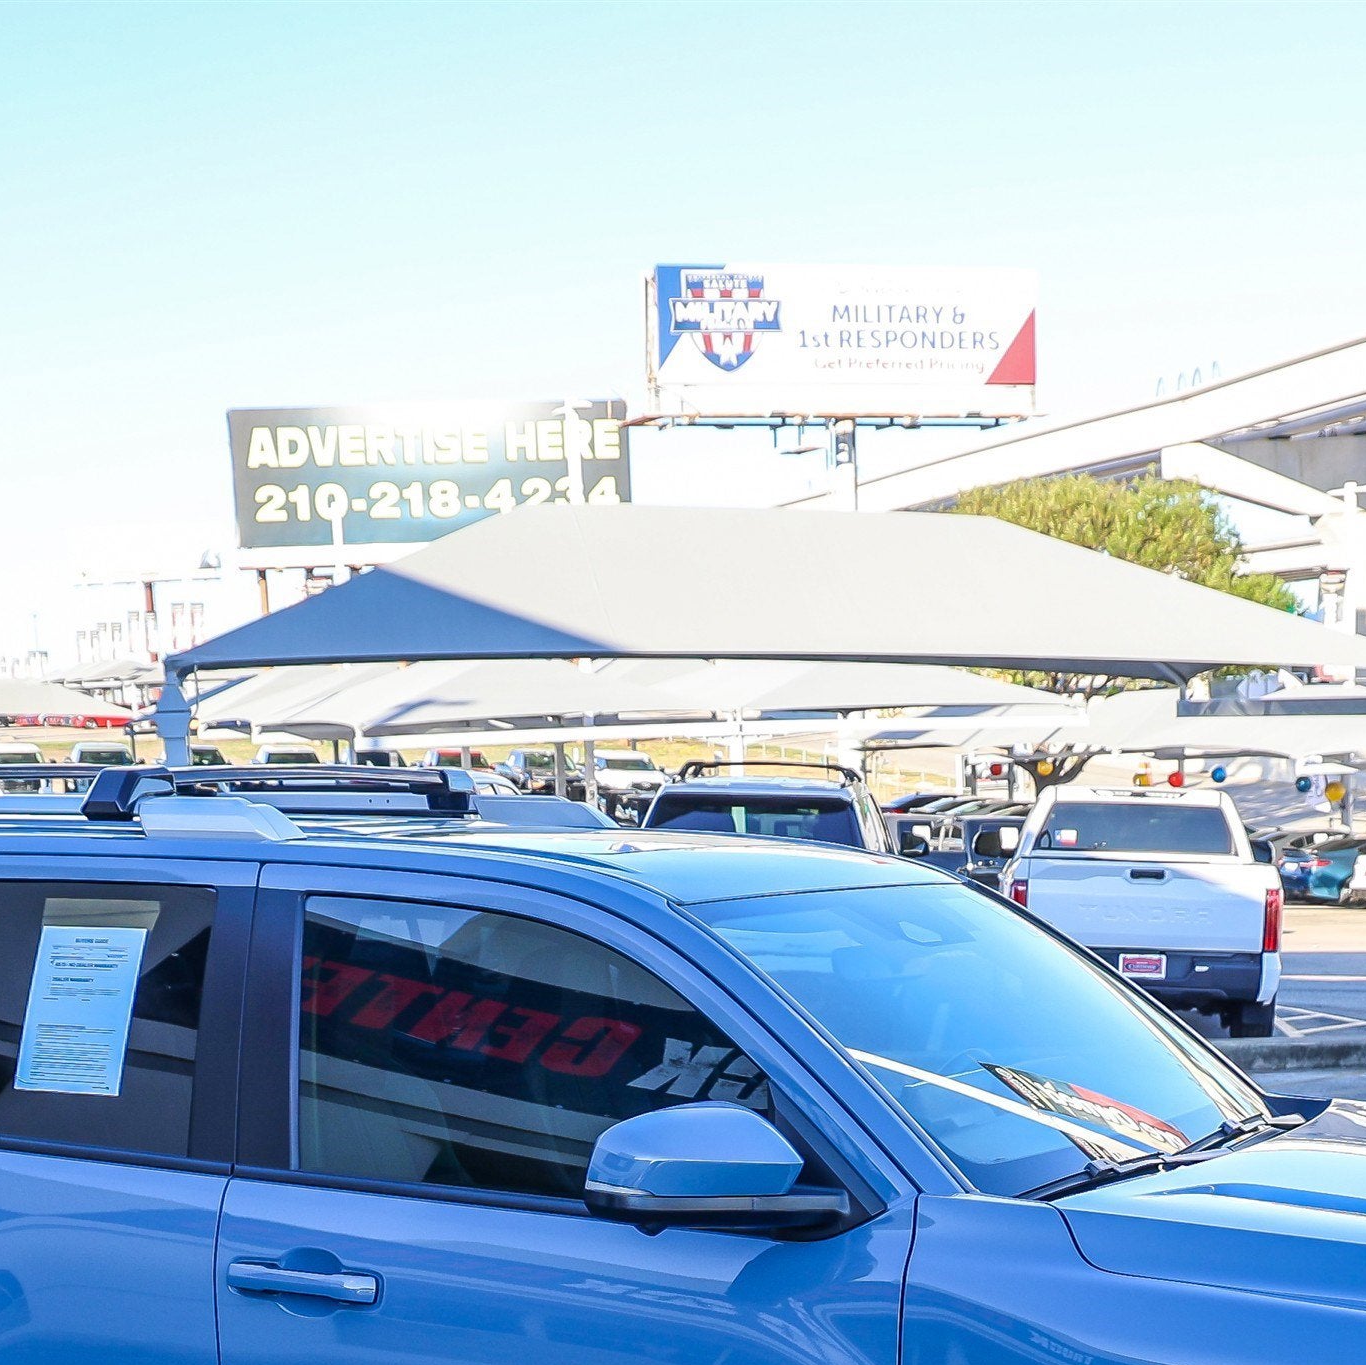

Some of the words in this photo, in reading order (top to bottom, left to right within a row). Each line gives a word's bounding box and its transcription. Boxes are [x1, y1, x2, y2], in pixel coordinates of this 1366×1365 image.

[674, 301, 778, 322] MILITARY
[832, 304, 944, 324] MILITARY
[951, 305, 966, 325] &
[798, 329, 831, 348] 1st
[839, 329, 1000, 350] RESPONDERS
[246, 424, 489, 469] ADVERTISE
[504, 418, 621, 462] HERE
